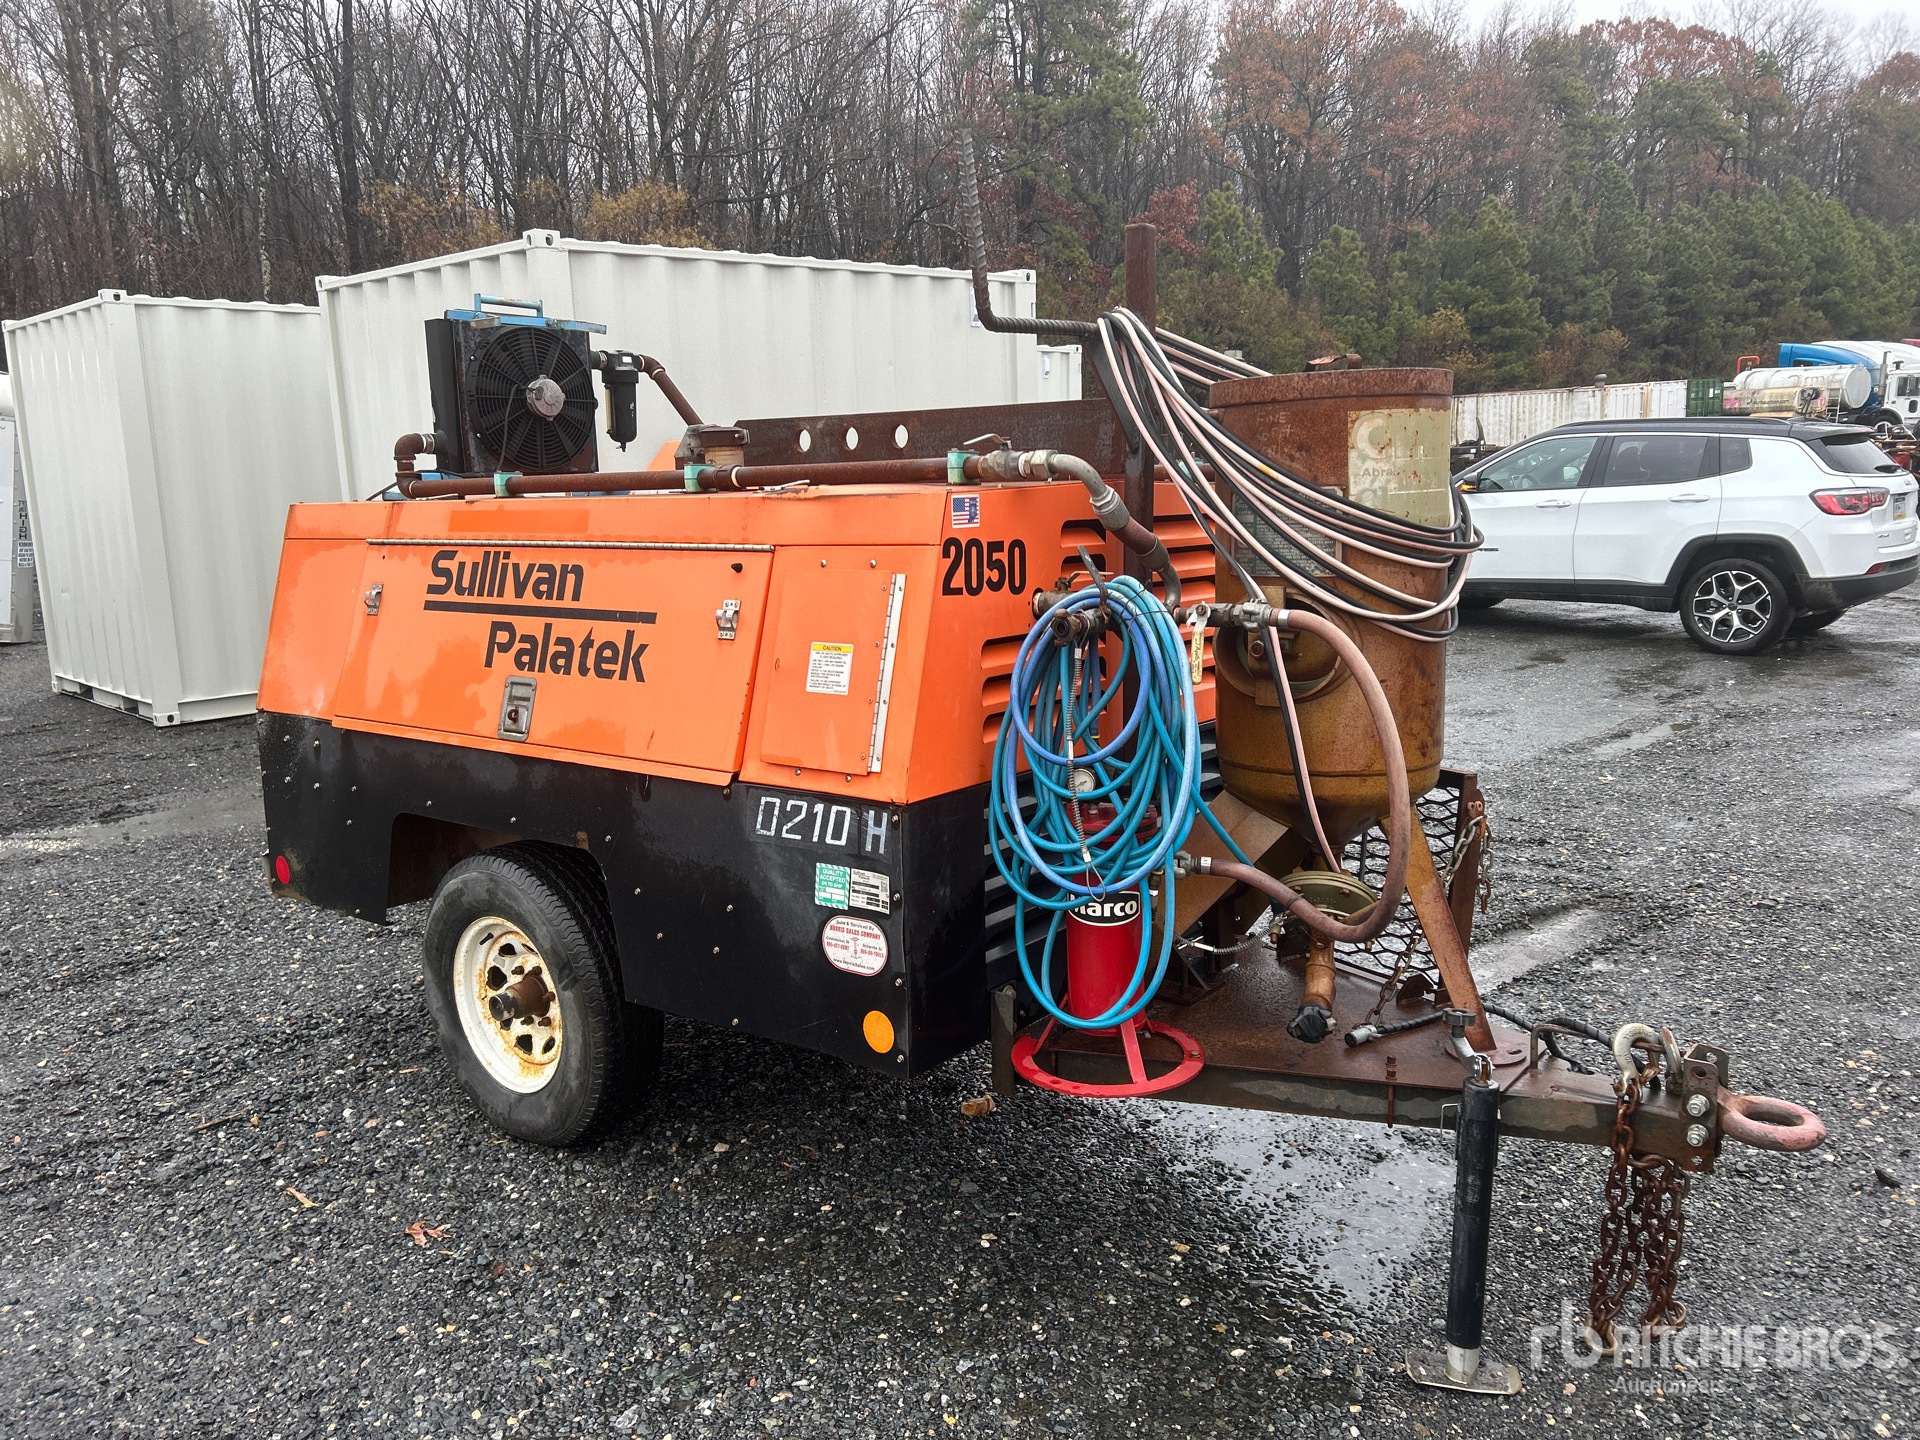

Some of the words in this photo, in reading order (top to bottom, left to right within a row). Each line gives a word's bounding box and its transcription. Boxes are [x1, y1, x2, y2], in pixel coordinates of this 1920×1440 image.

[426, 549, 585, 602] Sullivan
[942, 536, 1027, 597] 2050
[484, 620, 650, 683] Palatek
[755, 796, 852, 846] 0210
[865, 809, 888, 854] H
[820, 874, 846, 883] ACCEPTED
[846, 927, 860, 936] SALES
[860, 930, 881, 940] COMPANY
